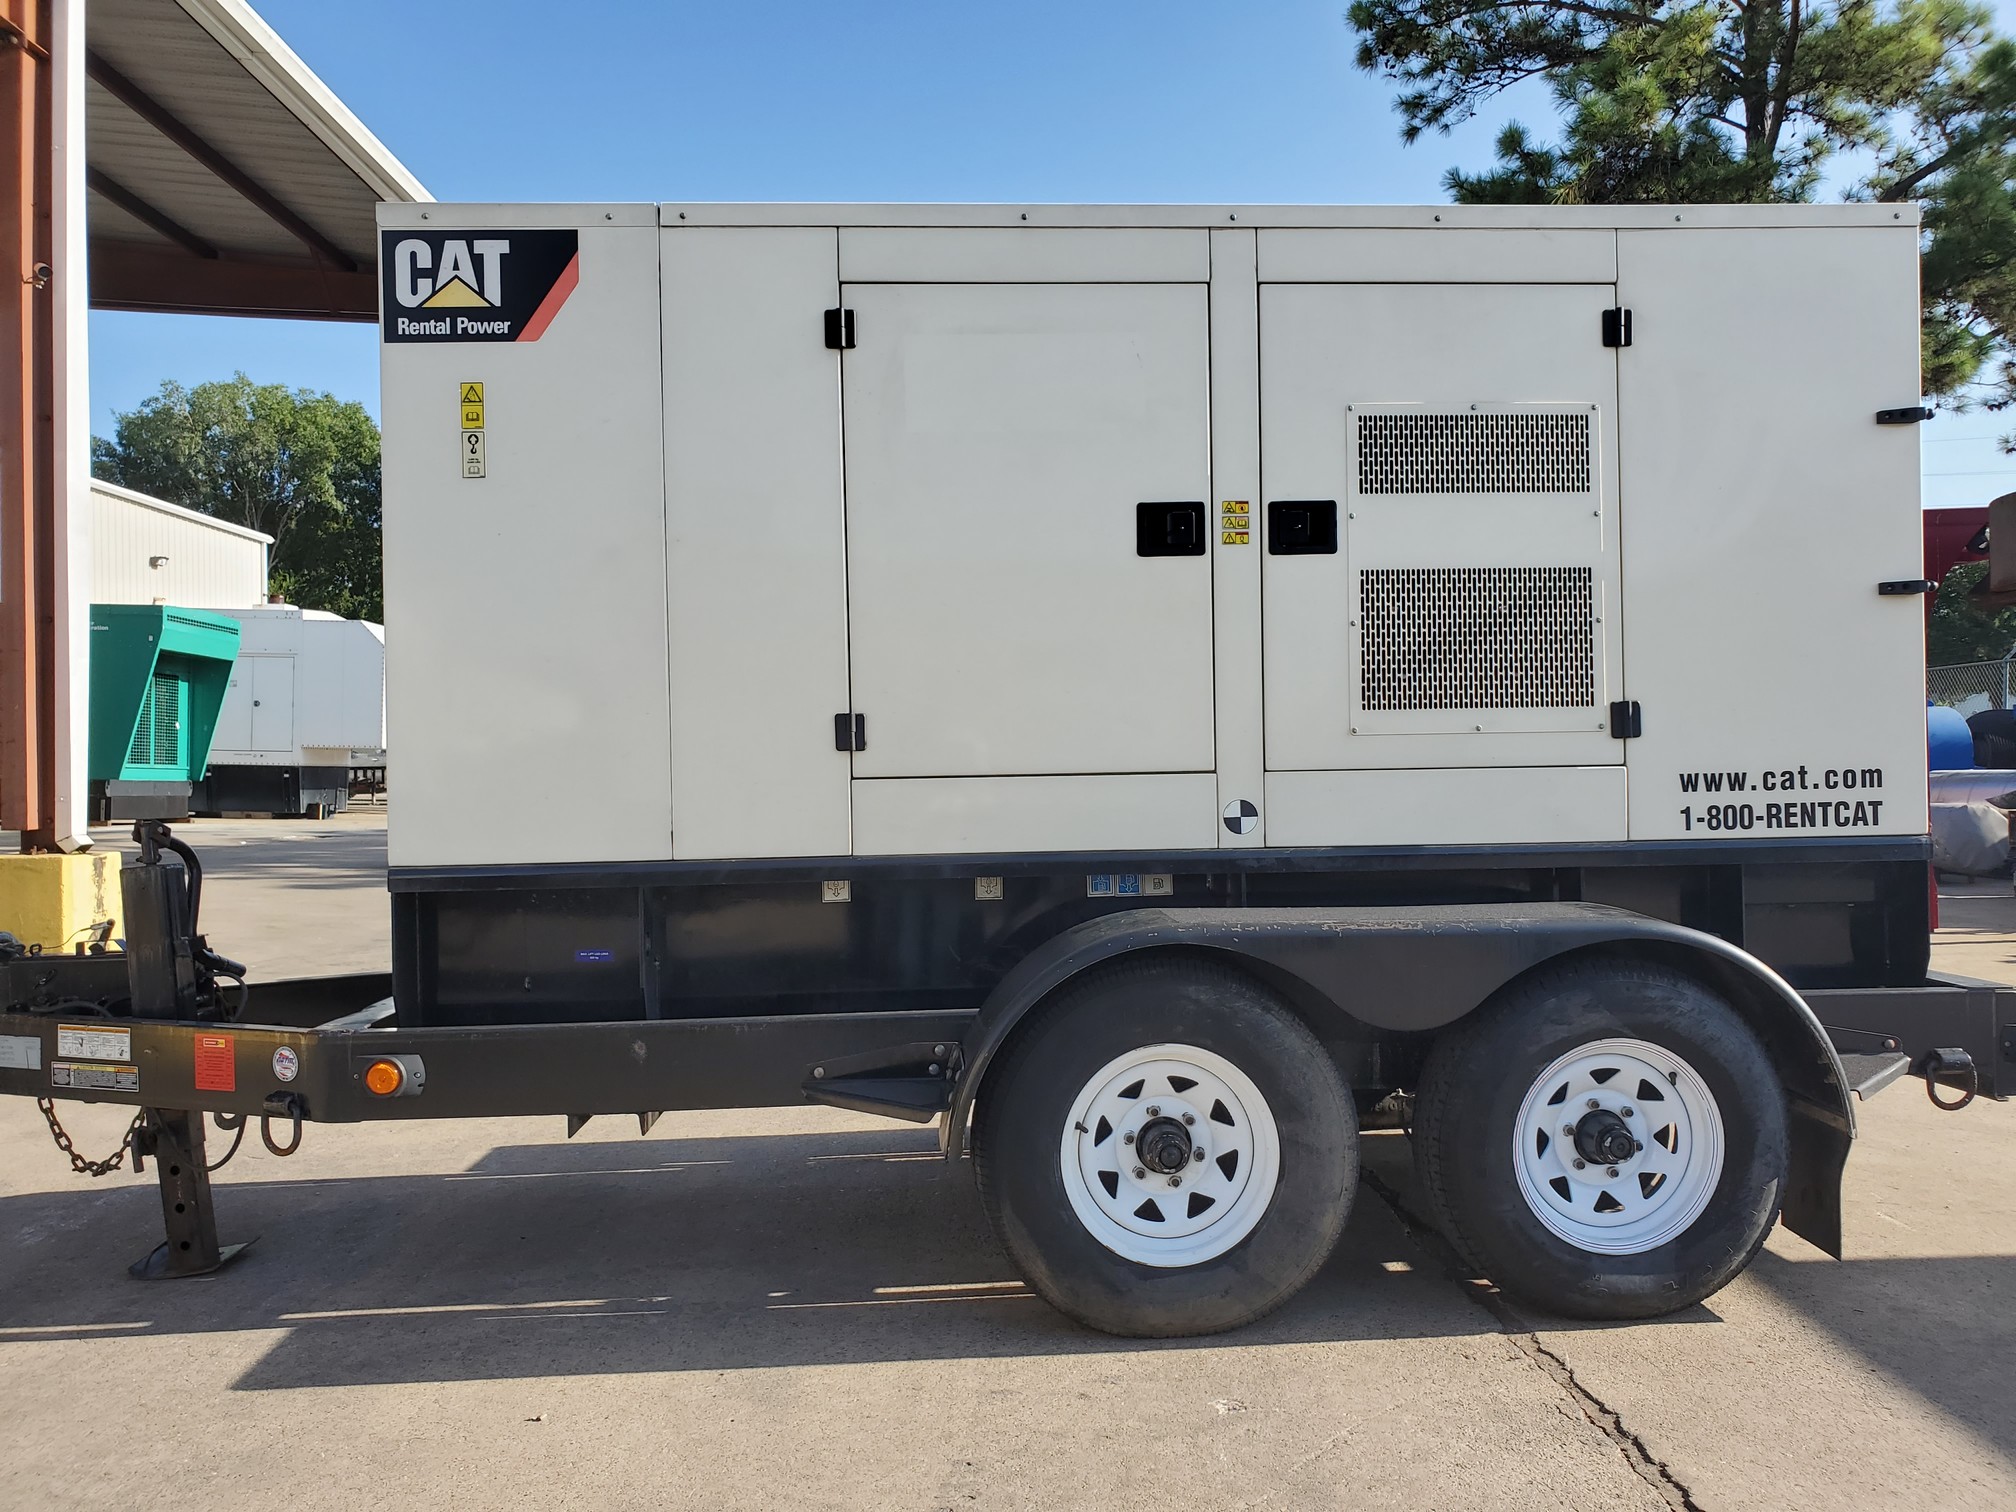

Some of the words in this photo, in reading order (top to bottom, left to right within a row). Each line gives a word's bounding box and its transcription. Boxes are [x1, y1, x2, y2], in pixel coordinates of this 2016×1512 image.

[395, 239, 510, 308] CAT
[398, 317, 450, 335] Rental
[457, 317, 511, 334] Power
[1679, 765, 1883, 793] www.cat.com
[1680, 801, 1883, 831] 1-800-RENTCAT
